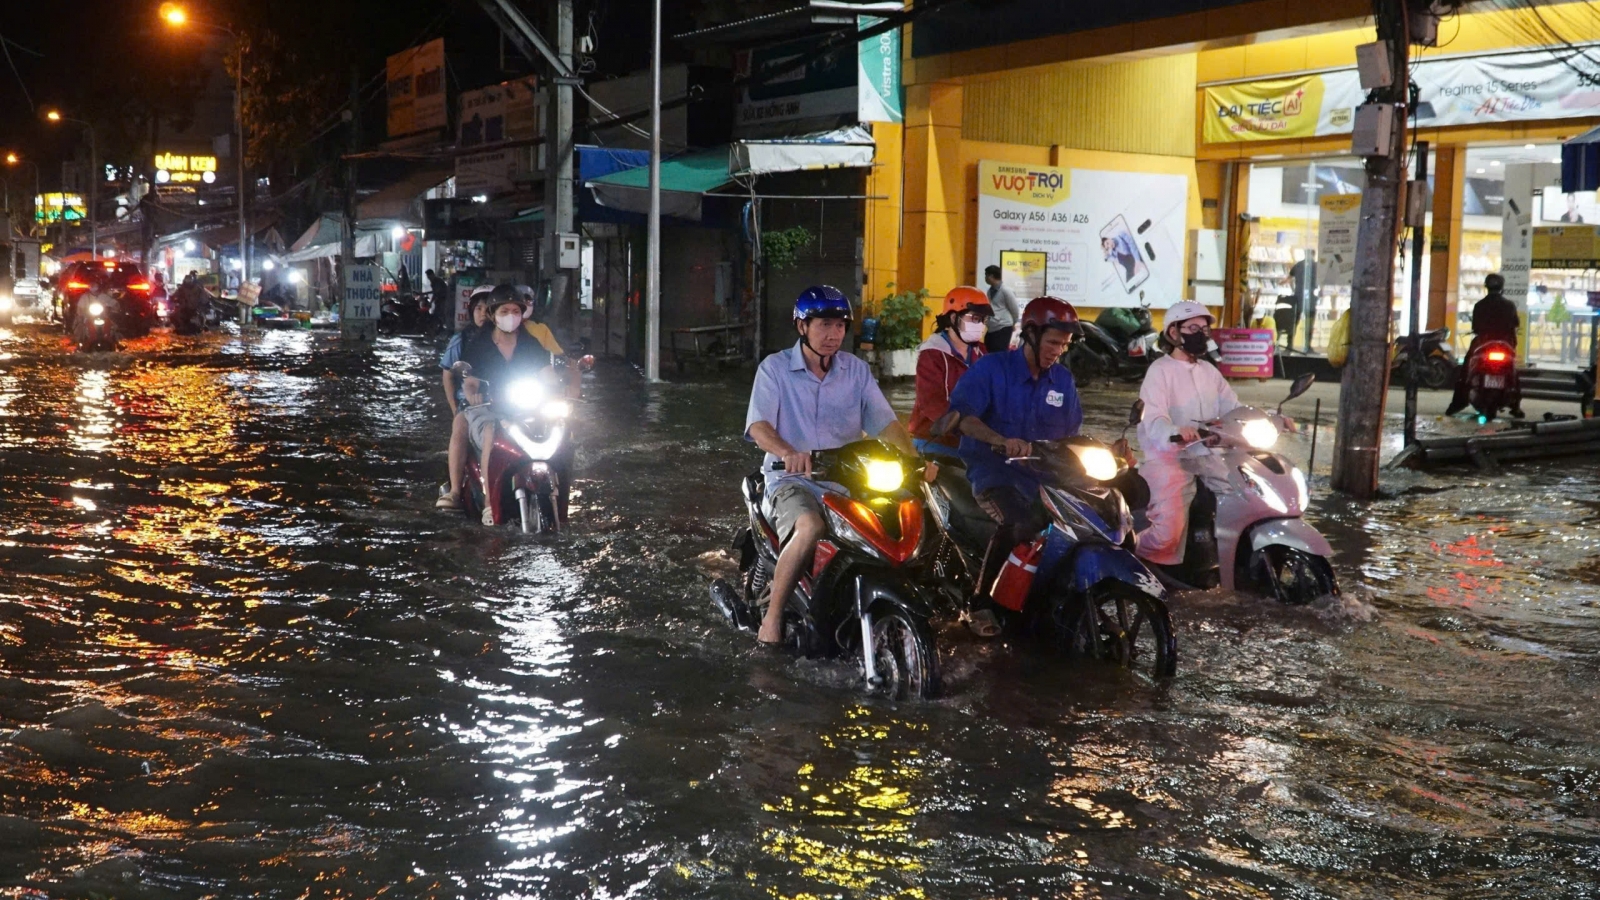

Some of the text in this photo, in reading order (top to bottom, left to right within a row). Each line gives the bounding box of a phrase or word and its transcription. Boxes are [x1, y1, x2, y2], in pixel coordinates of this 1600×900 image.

[881, 57, 892, 98] vistra
[1439, 80, 1537, 98] realme 15 Series
[1247, 98, 1282, 117] TIỆC
[1287, 98, 1299, 111] AI
[155, 152, 187, 170] BÁNH
[998, 166, 1027, 174] SAMSUNG
[993, 209, 1089, 223] Galaxy A56 A36 A26
[353, 267, 373, 282] NHÀ
[346, 285, 380, 299] THUỐC
[353, 303, 372, 317] TÂY
